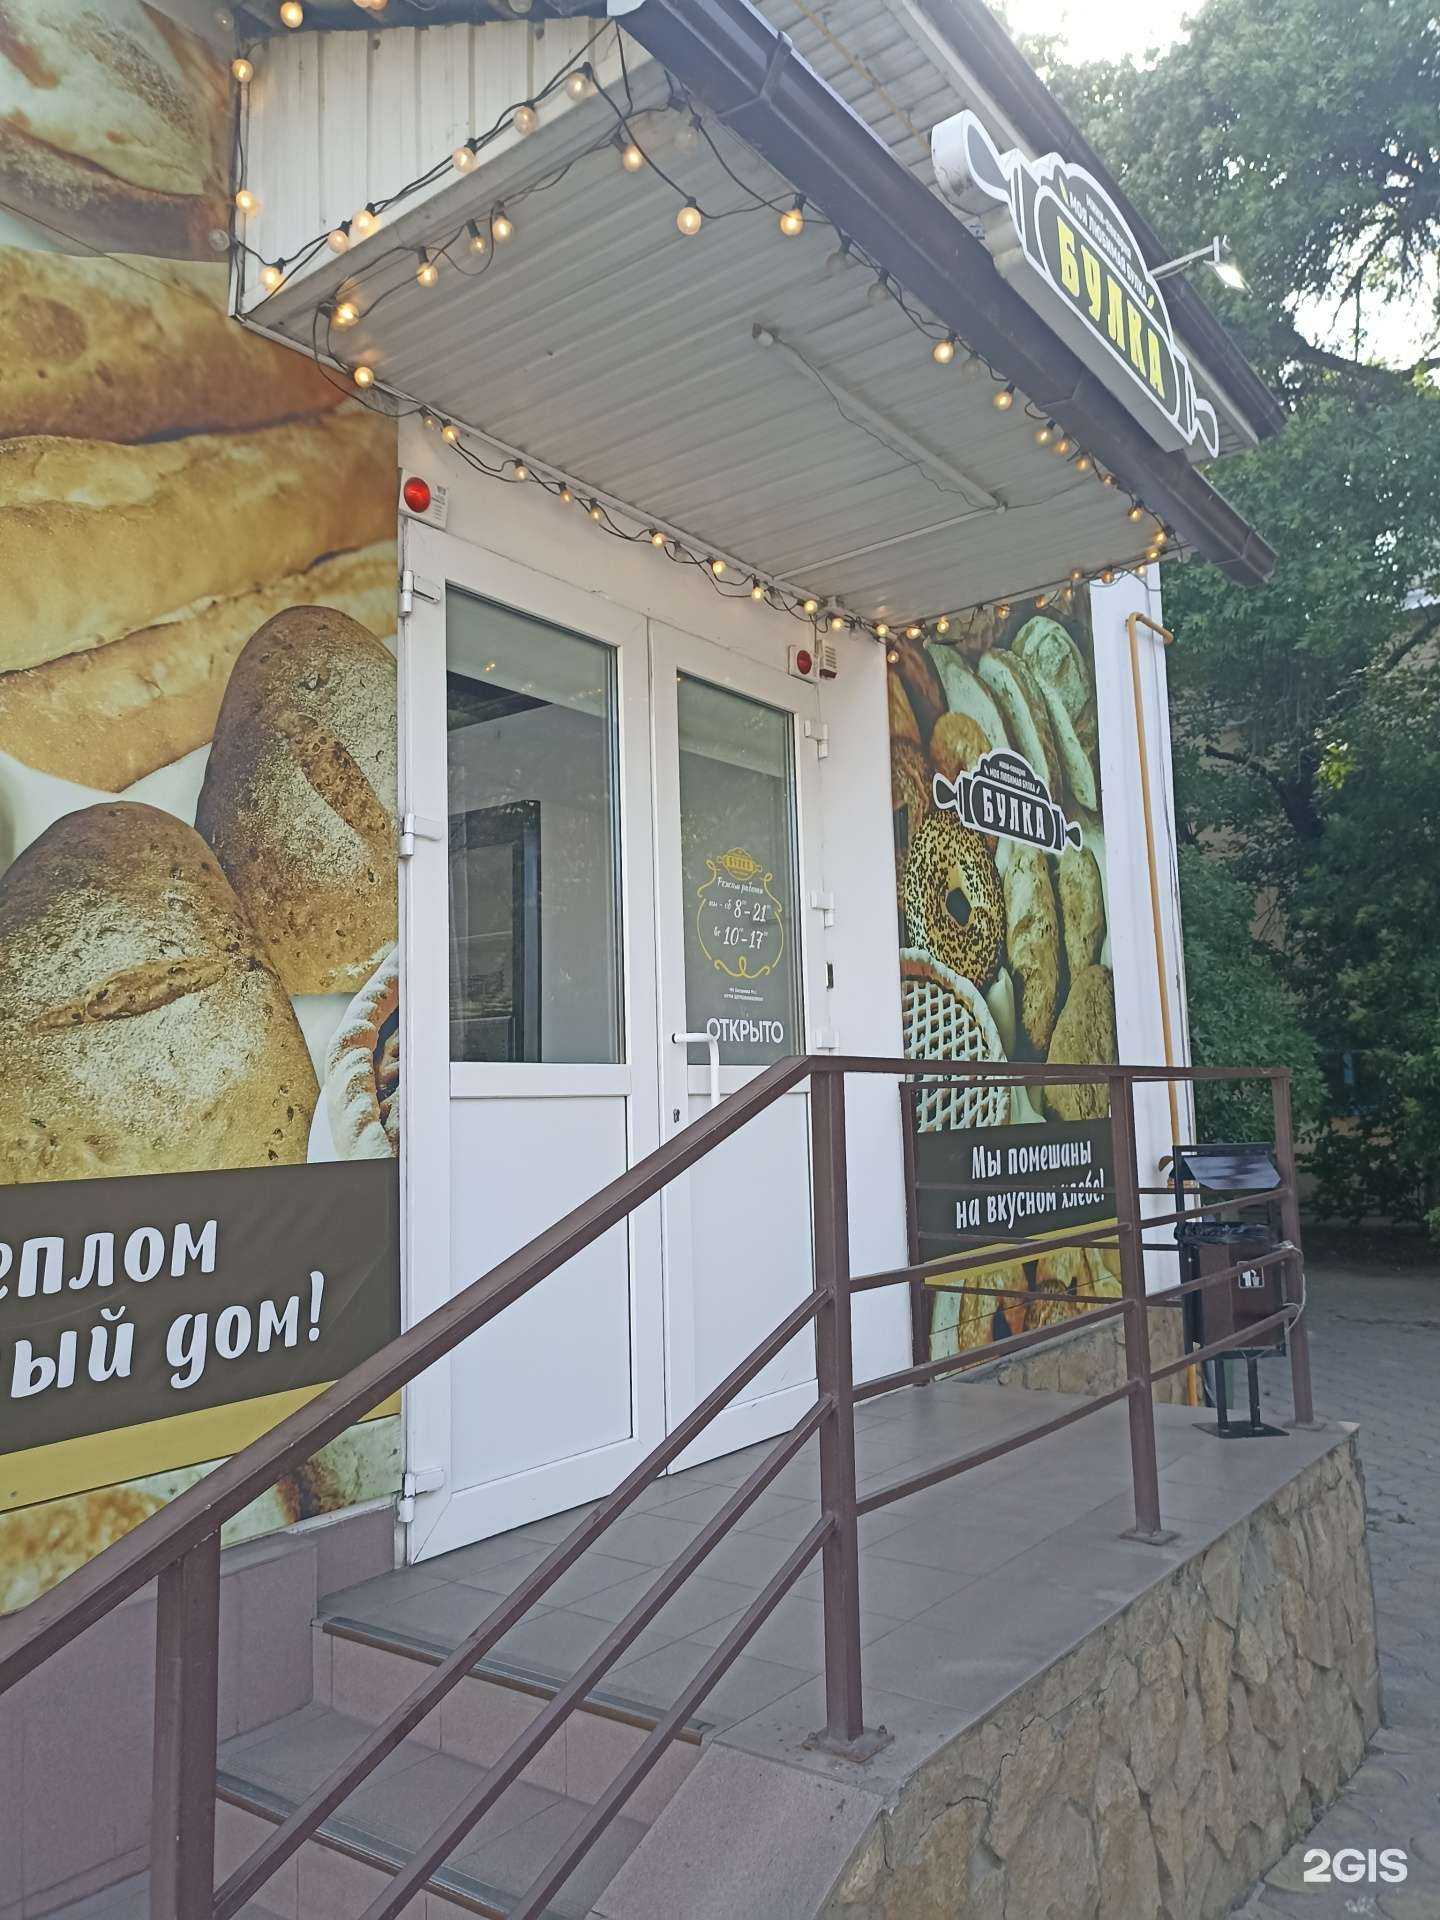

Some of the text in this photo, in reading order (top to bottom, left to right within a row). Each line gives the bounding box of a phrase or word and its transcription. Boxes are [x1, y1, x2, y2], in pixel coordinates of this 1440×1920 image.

[1056, 214, 1166, 399] БУЛКА
[982, 786, 1046, 841] БУЛКА
[706, 1017, 784, 1044] ОТКРЫТО
[971, 1140, 1092, 1180] Мы помешаны
[956, 1199, 981, 1230] на
[986, 1187, 1057, 1230] вкусном
[165, 1270, 326, 1390] дом!
